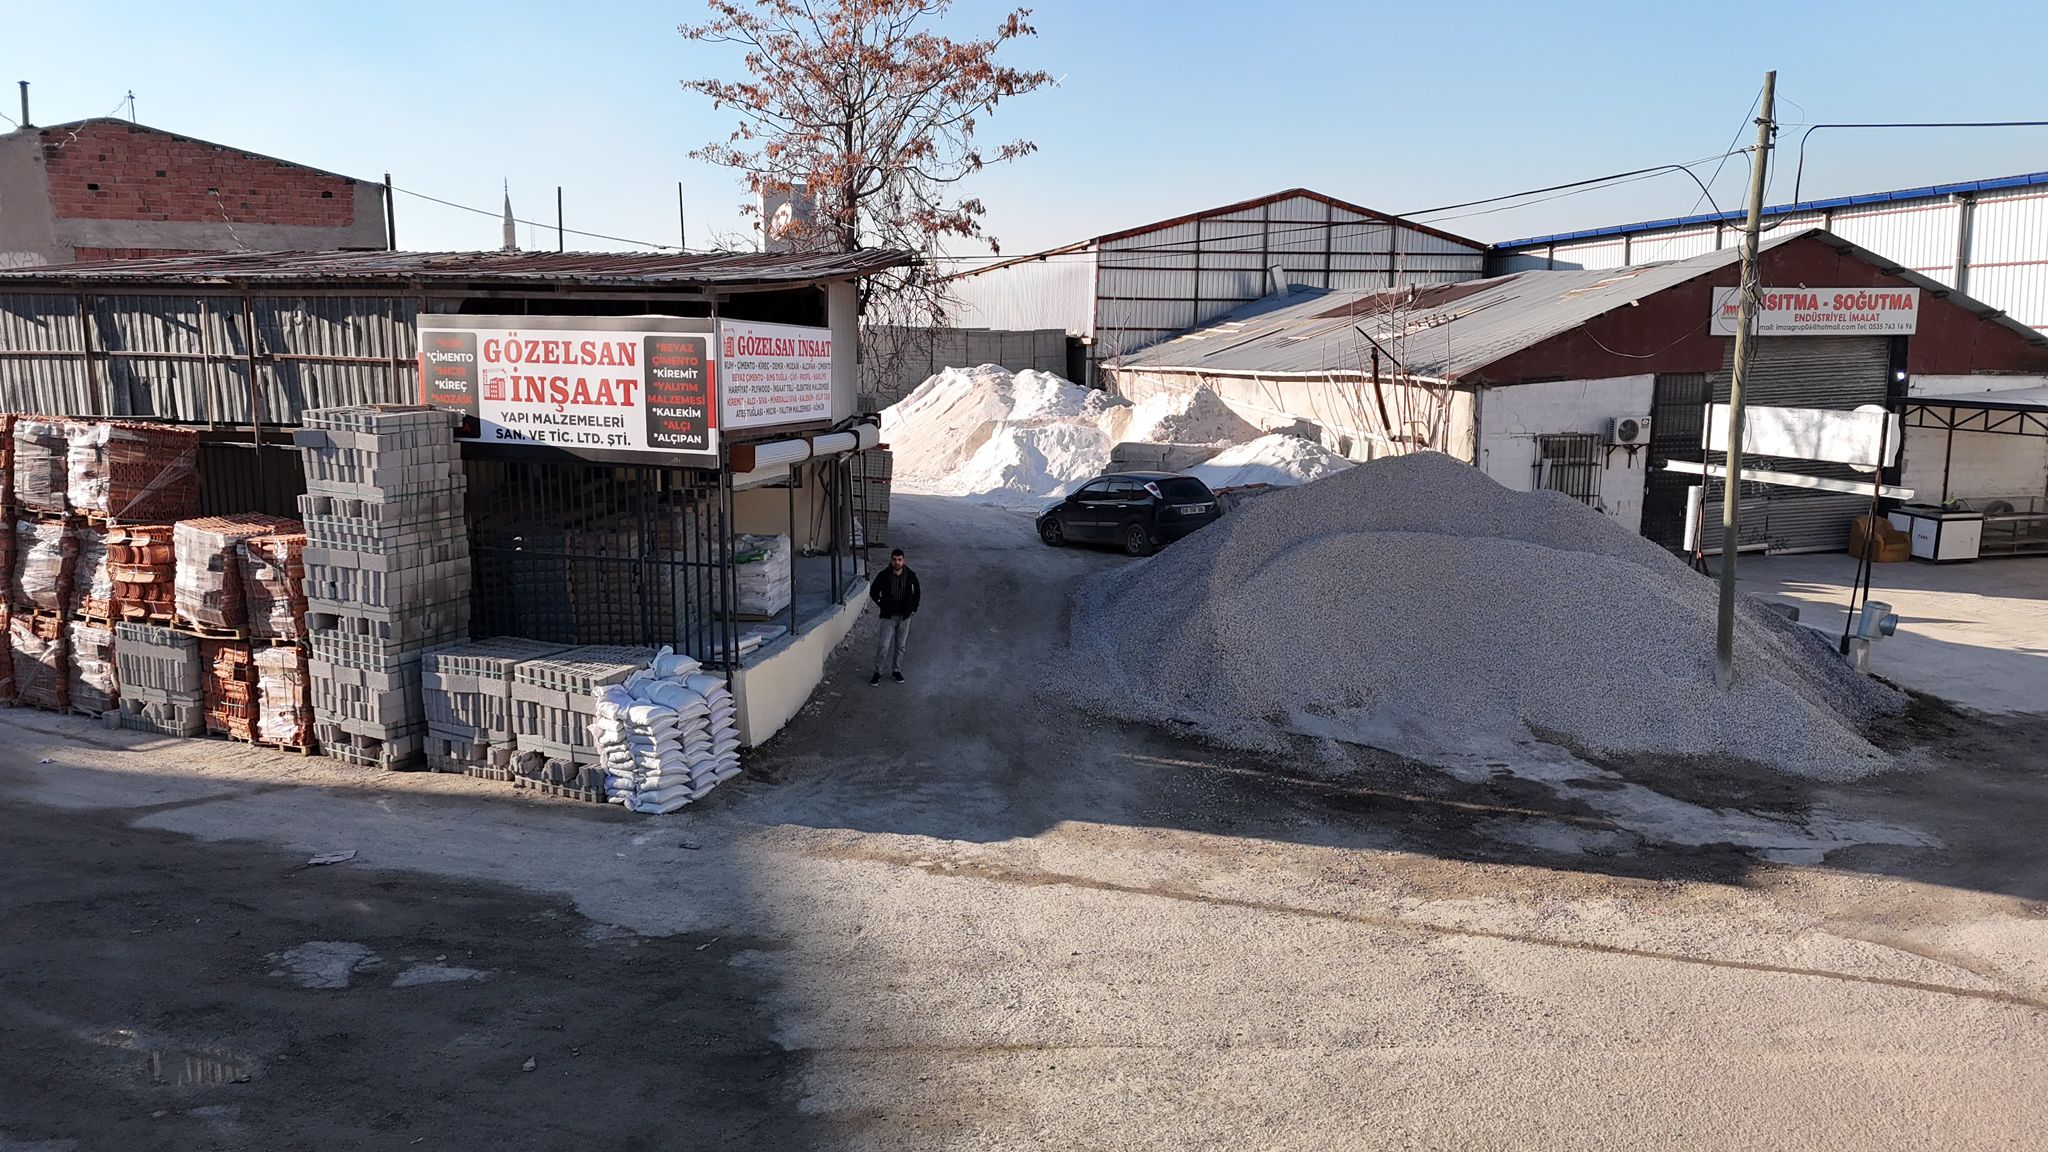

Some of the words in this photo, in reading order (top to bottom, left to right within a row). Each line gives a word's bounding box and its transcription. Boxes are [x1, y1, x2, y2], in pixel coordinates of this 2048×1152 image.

[1833, 290, 1913, 310] SOĞUTMA
[1794, 312, 1846, 322] ENDÜSTRİYEL
[1849, 312, 1880, 322] İMALAT
[483, 331, 636, 367] GÖZELSAN
[738, 330, 795, 357] GÖZELSAN
[798, 334, 831, 362] İNŞAAT
[510, 366, 638, 412] İNŞAAT
[648, 394, 705, 406] MALZEMESİ
[501, 411, 529, 423] YAPI
[532, 412, 624, 428] MALZEMELERİ
[496, 428, 526, 440] SAN.
[529, 429, 546, 441] VE
[550, 428, 574, 443] TİC.
[577, 432, 604, 444] LTD.
[607, 431, 631, 447] ŞTİ.
